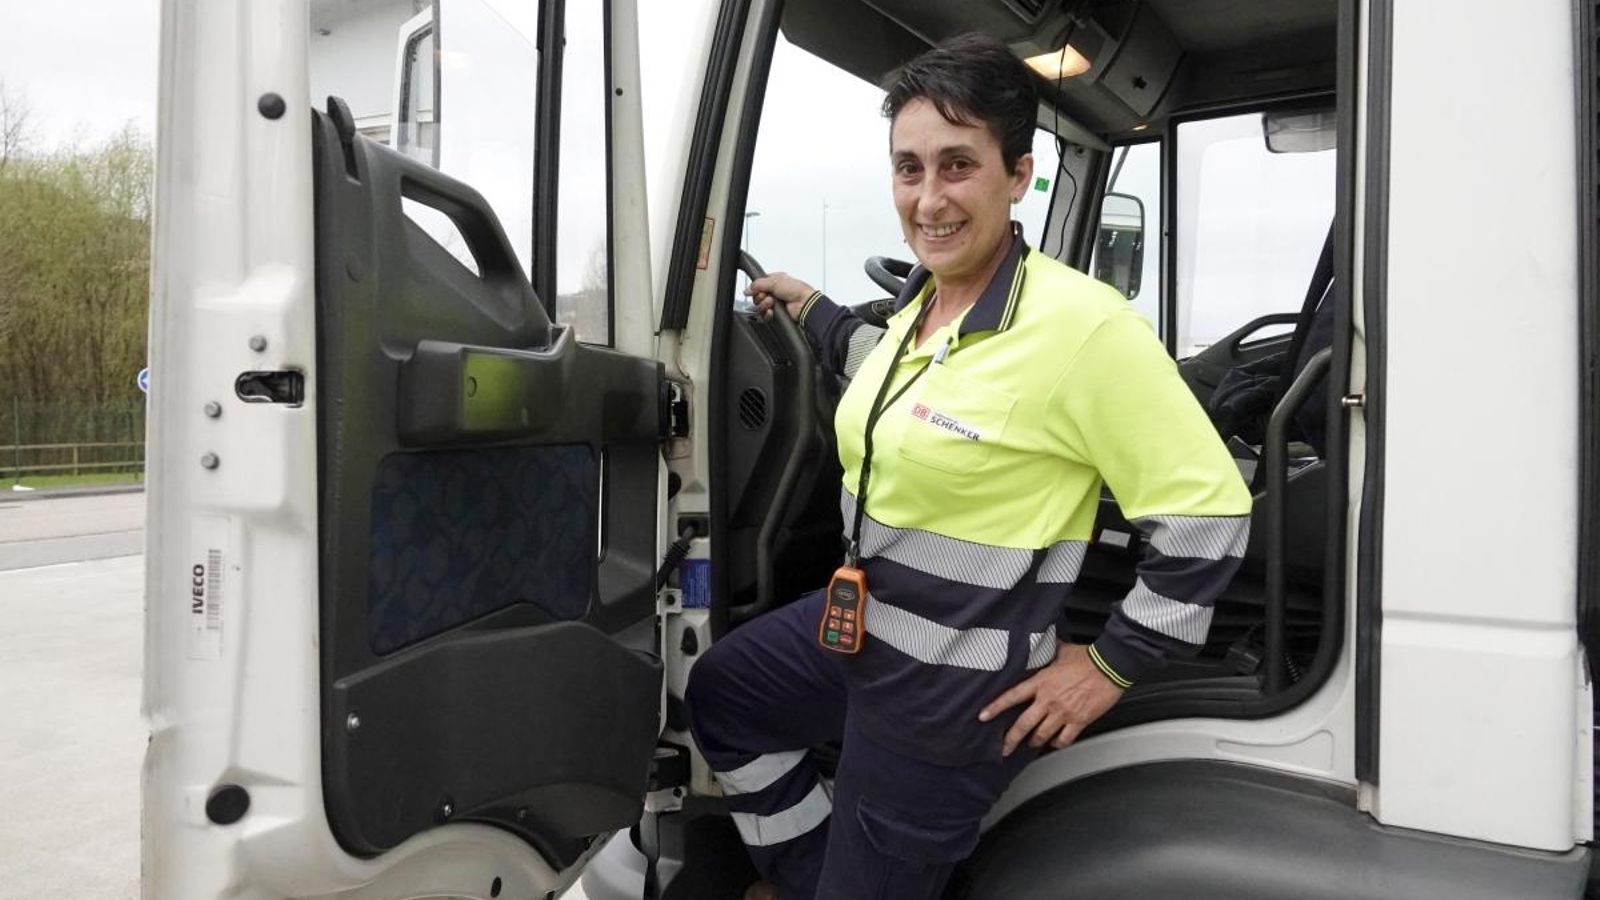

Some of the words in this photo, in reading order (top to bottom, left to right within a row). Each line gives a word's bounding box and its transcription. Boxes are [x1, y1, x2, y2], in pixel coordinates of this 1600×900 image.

[913, 405, 929, 418] DB
[930, 416, 980, 441] SCHENKER
[192, 564, 204, 614] IVECO
